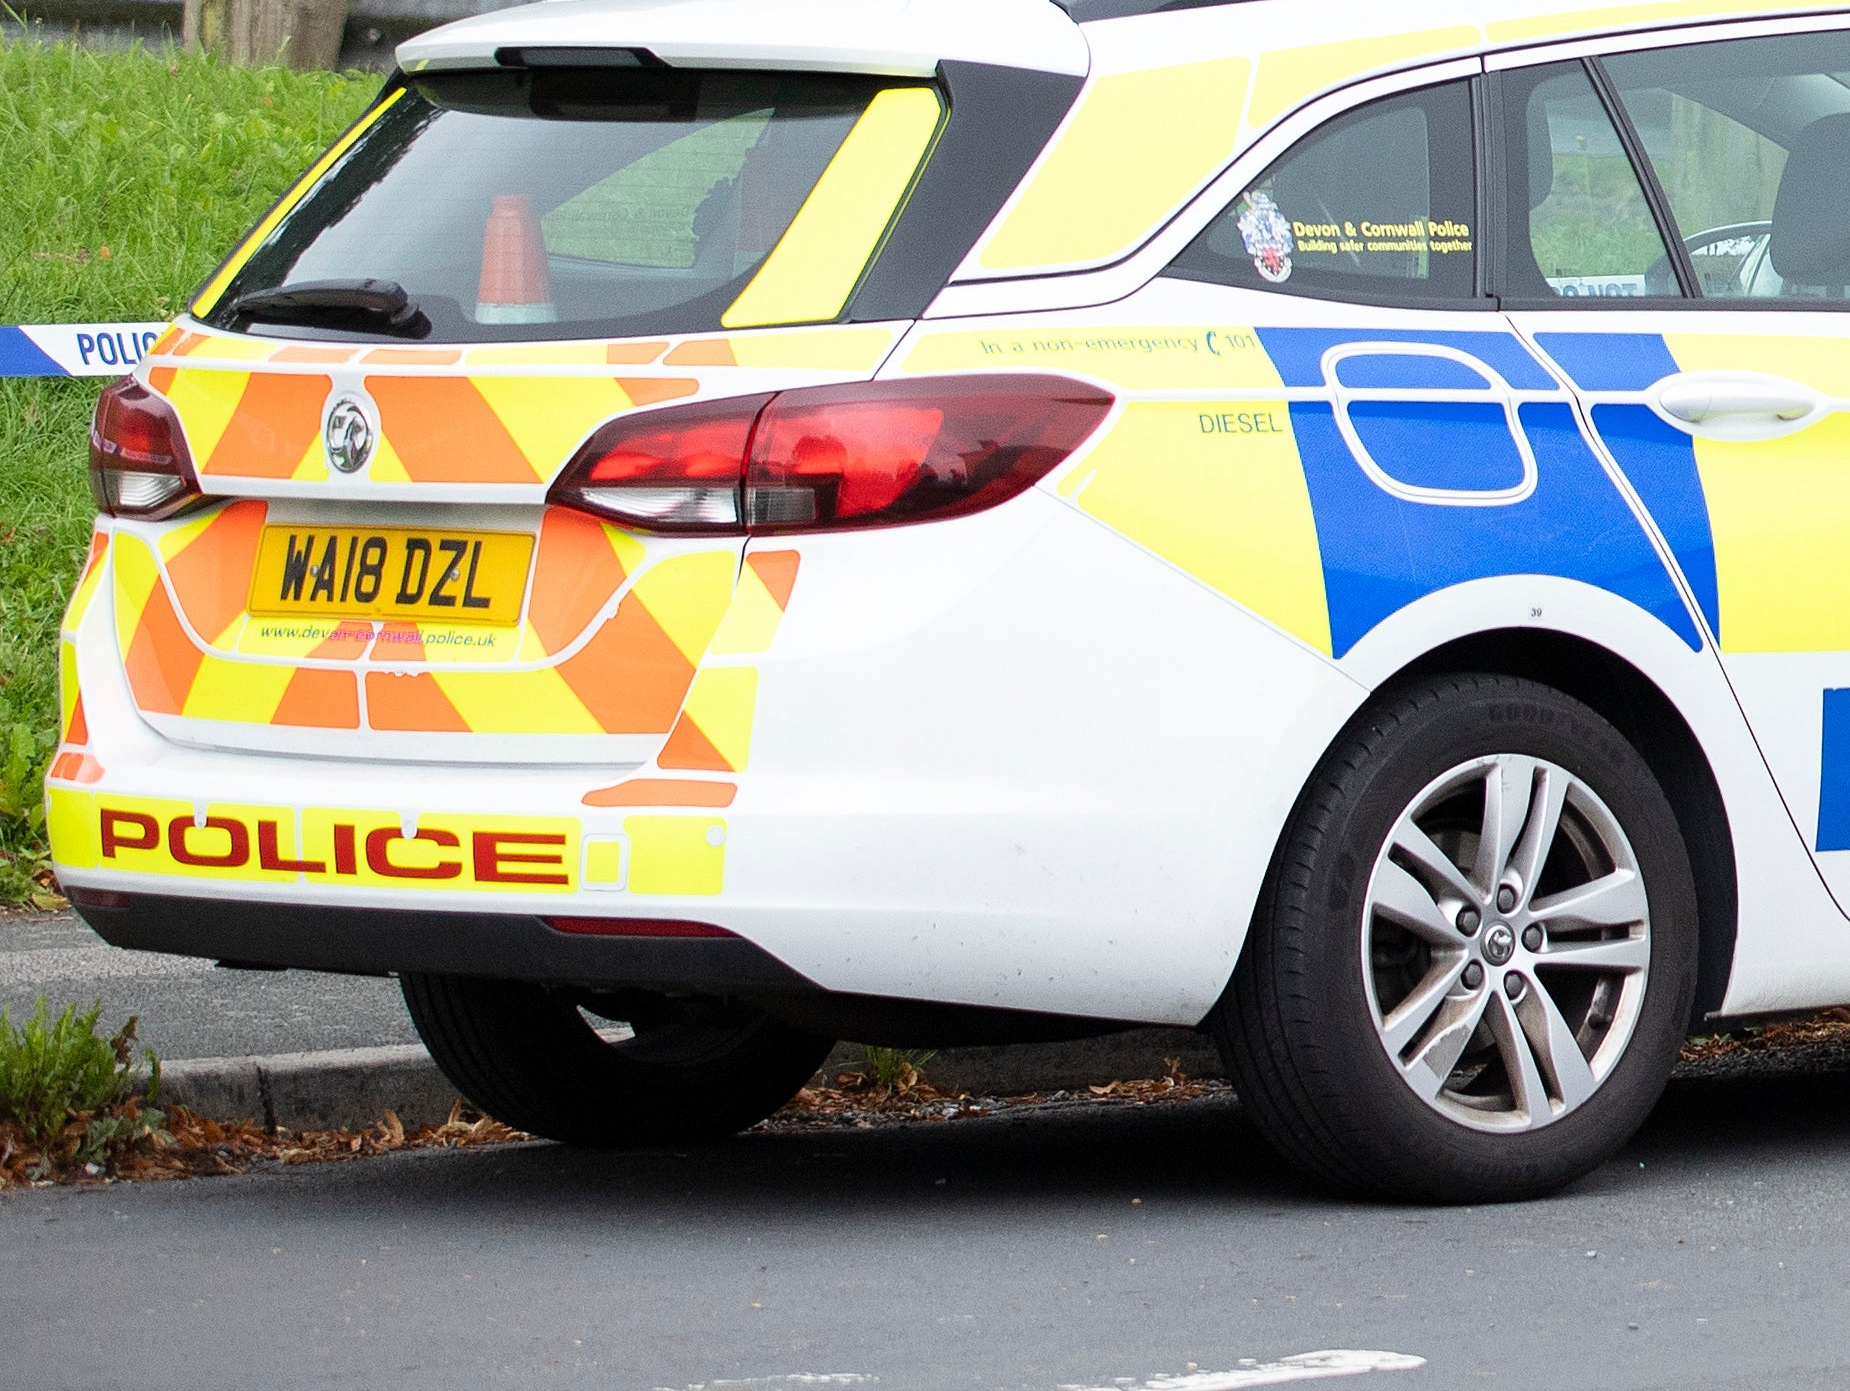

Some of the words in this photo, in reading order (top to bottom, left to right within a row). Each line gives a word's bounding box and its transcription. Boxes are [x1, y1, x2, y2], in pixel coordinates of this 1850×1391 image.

[1292, 220, 1341, 238] Devon
[1344, 221, 1357, 238] &
[1360, 220, 1425, 238] Cornwall
[1427, 220, 1470, 238] Police
[1297, 239, 1338, 254] Building
[1339, 239, 1364, 252] safer
[1367, 239, 1428, 252] communities
[1430, 238, 1473, 254] together
[980, 339, 1002, 354] In
[1012, 341, 1024, 354] a
[1032, 335, 1198, 354] non-emergency
[1225, 333, 1256, 349] 101
[1199, 412, 1284, 435] DIESEL
[279, 534, 388, 604] WA18
[395, 537, 491, 609] DZL
[260, 624, 496, 648] www.devon-cornwall.police.uk
[100, 807, 569, 885] POLICE
